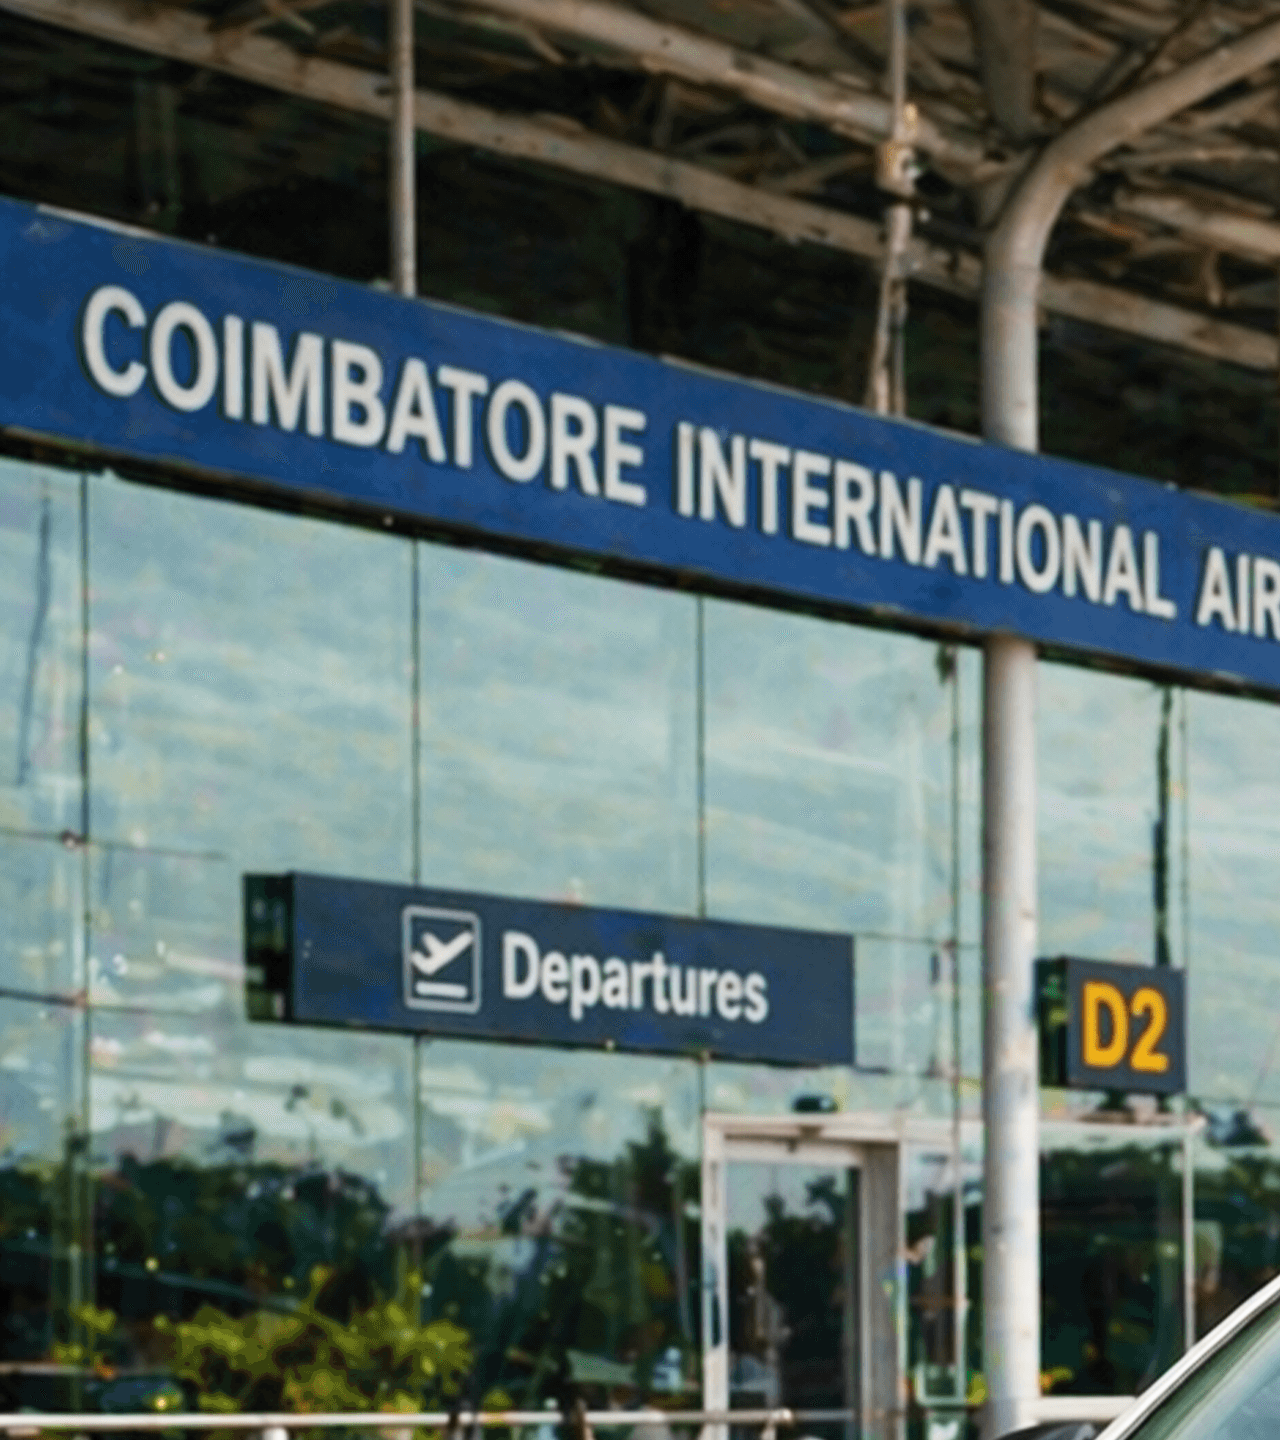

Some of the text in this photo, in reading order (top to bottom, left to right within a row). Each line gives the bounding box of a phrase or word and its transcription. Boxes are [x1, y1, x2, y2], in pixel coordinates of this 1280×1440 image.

[82, 285, 647, 506] COIMBATORE
[676, 421, 1177, 620] INTERNATIONAL
[503, 931, 769, 1023] Departures
[1082, 980, 1169, 1074] D2
